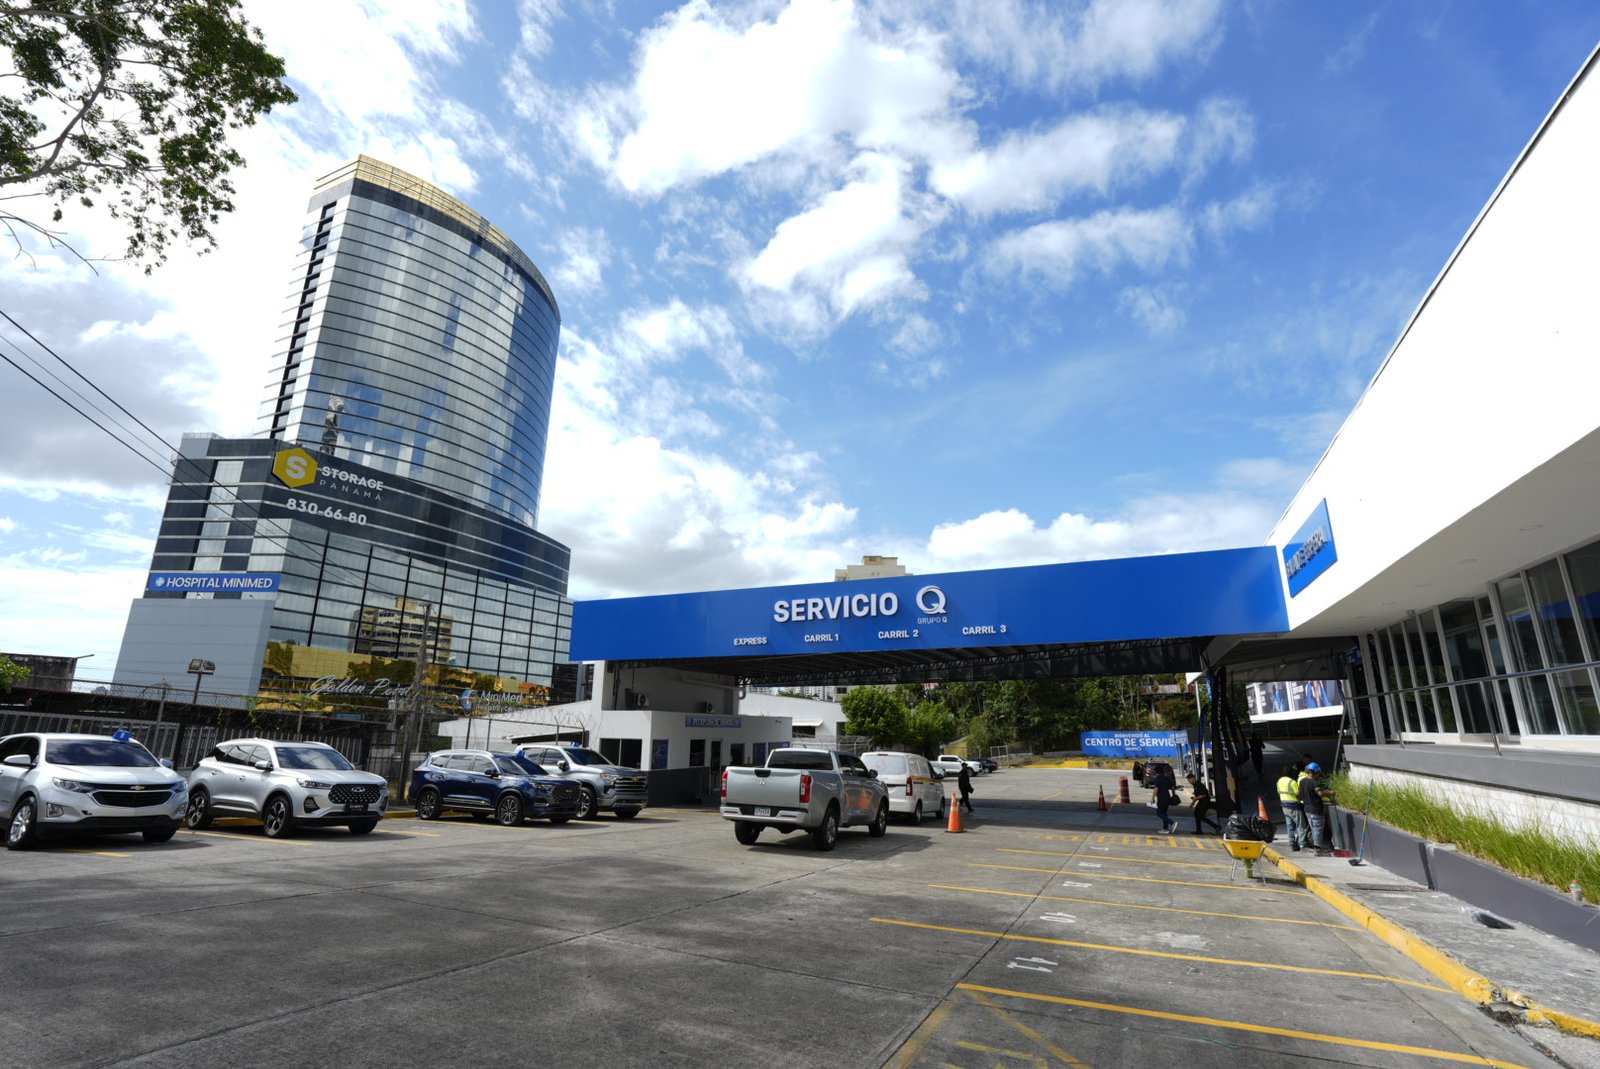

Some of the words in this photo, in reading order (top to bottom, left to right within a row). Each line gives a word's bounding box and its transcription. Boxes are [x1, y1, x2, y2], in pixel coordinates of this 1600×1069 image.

[321, 466, 384, 491] STORAGE
[286, 498, 367, 525] 830-66-80
[167, 577, 220, 588] HOSPITAL
[222, 577, 273, 588] MINIMED
[916, 585, 947, 615] Q
[773, 592, 898, 622] SERVICIO
[917, 617, 941, 625] GRUPO
[878, 630, 909, 639] CARRIL
[912, 629, 919, 638] 2
[962, 625, 997, 635] CARRIL
[1000, 624, 1007, 633] 3
[733, 636, 768, 646] EXPRESS
[804, 634, 833, 643] CARRIL
[834, 633, 839, 641] 1
[306, 675, 366, 696] Golden
[480, 690, 523, 705] MiniMed
[1085, 738, 1122, 747] CENTRO
[1124, 738, 1137, 747] DE
